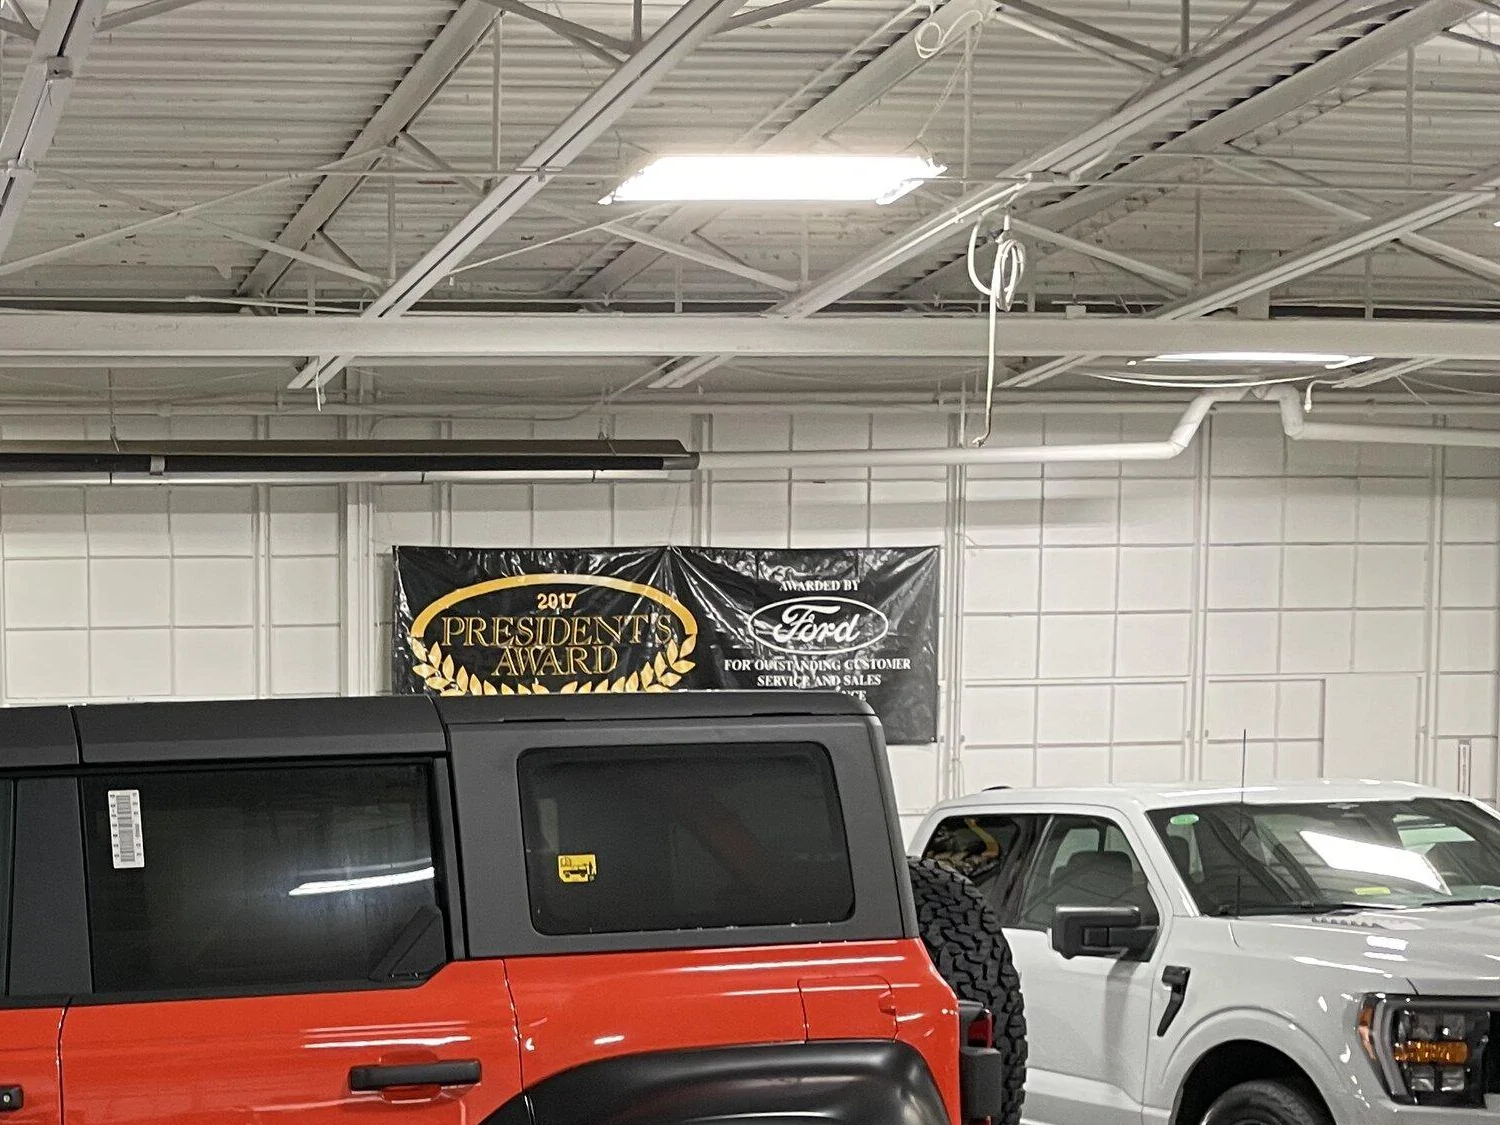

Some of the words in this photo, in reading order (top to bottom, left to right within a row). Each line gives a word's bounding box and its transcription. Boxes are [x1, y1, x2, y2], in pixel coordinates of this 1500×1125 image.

[779, 579, 841, 592] AWARDED
[843, 579, 861, 592] BY
[536, 592, 578, 610] 2017
[440, 613, 676, 648] PRESIDENT'S
[772, 604, 861, 643] Ford
[490, 644, 620, 677] AWARD
[724, 658, 751, 671] FOR
[754, 658, 842, 671] OUTSTANDING
[757, 674, 810, 688] SERVICE
[815, 674, 842, 687] AND
[843, 673, 882, 687] SALES
